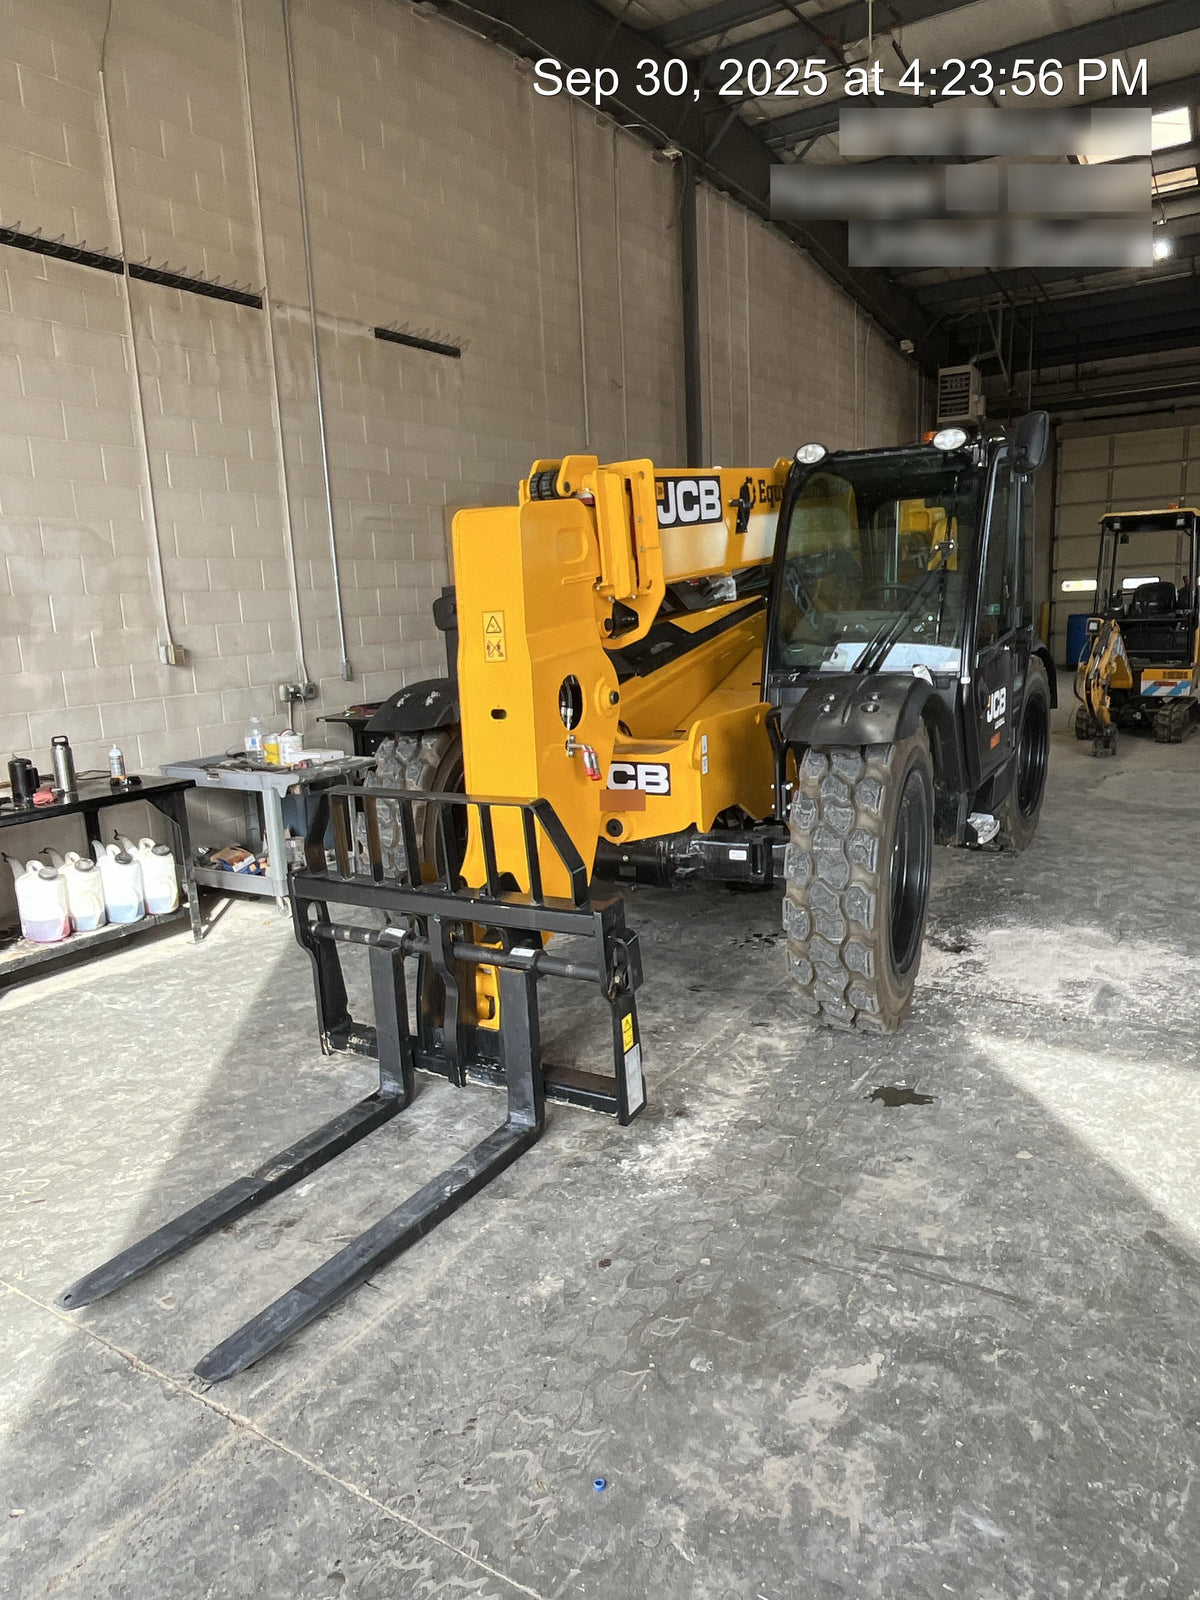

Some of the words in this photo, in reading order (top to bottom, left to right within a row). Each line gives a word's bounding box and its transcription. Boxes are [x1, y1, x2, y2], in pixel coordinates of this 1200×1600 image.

[657, 480, 721, 525] JCB
[986, 687, 1007, 723] JCB
[607, 763, 670, 794] CB
